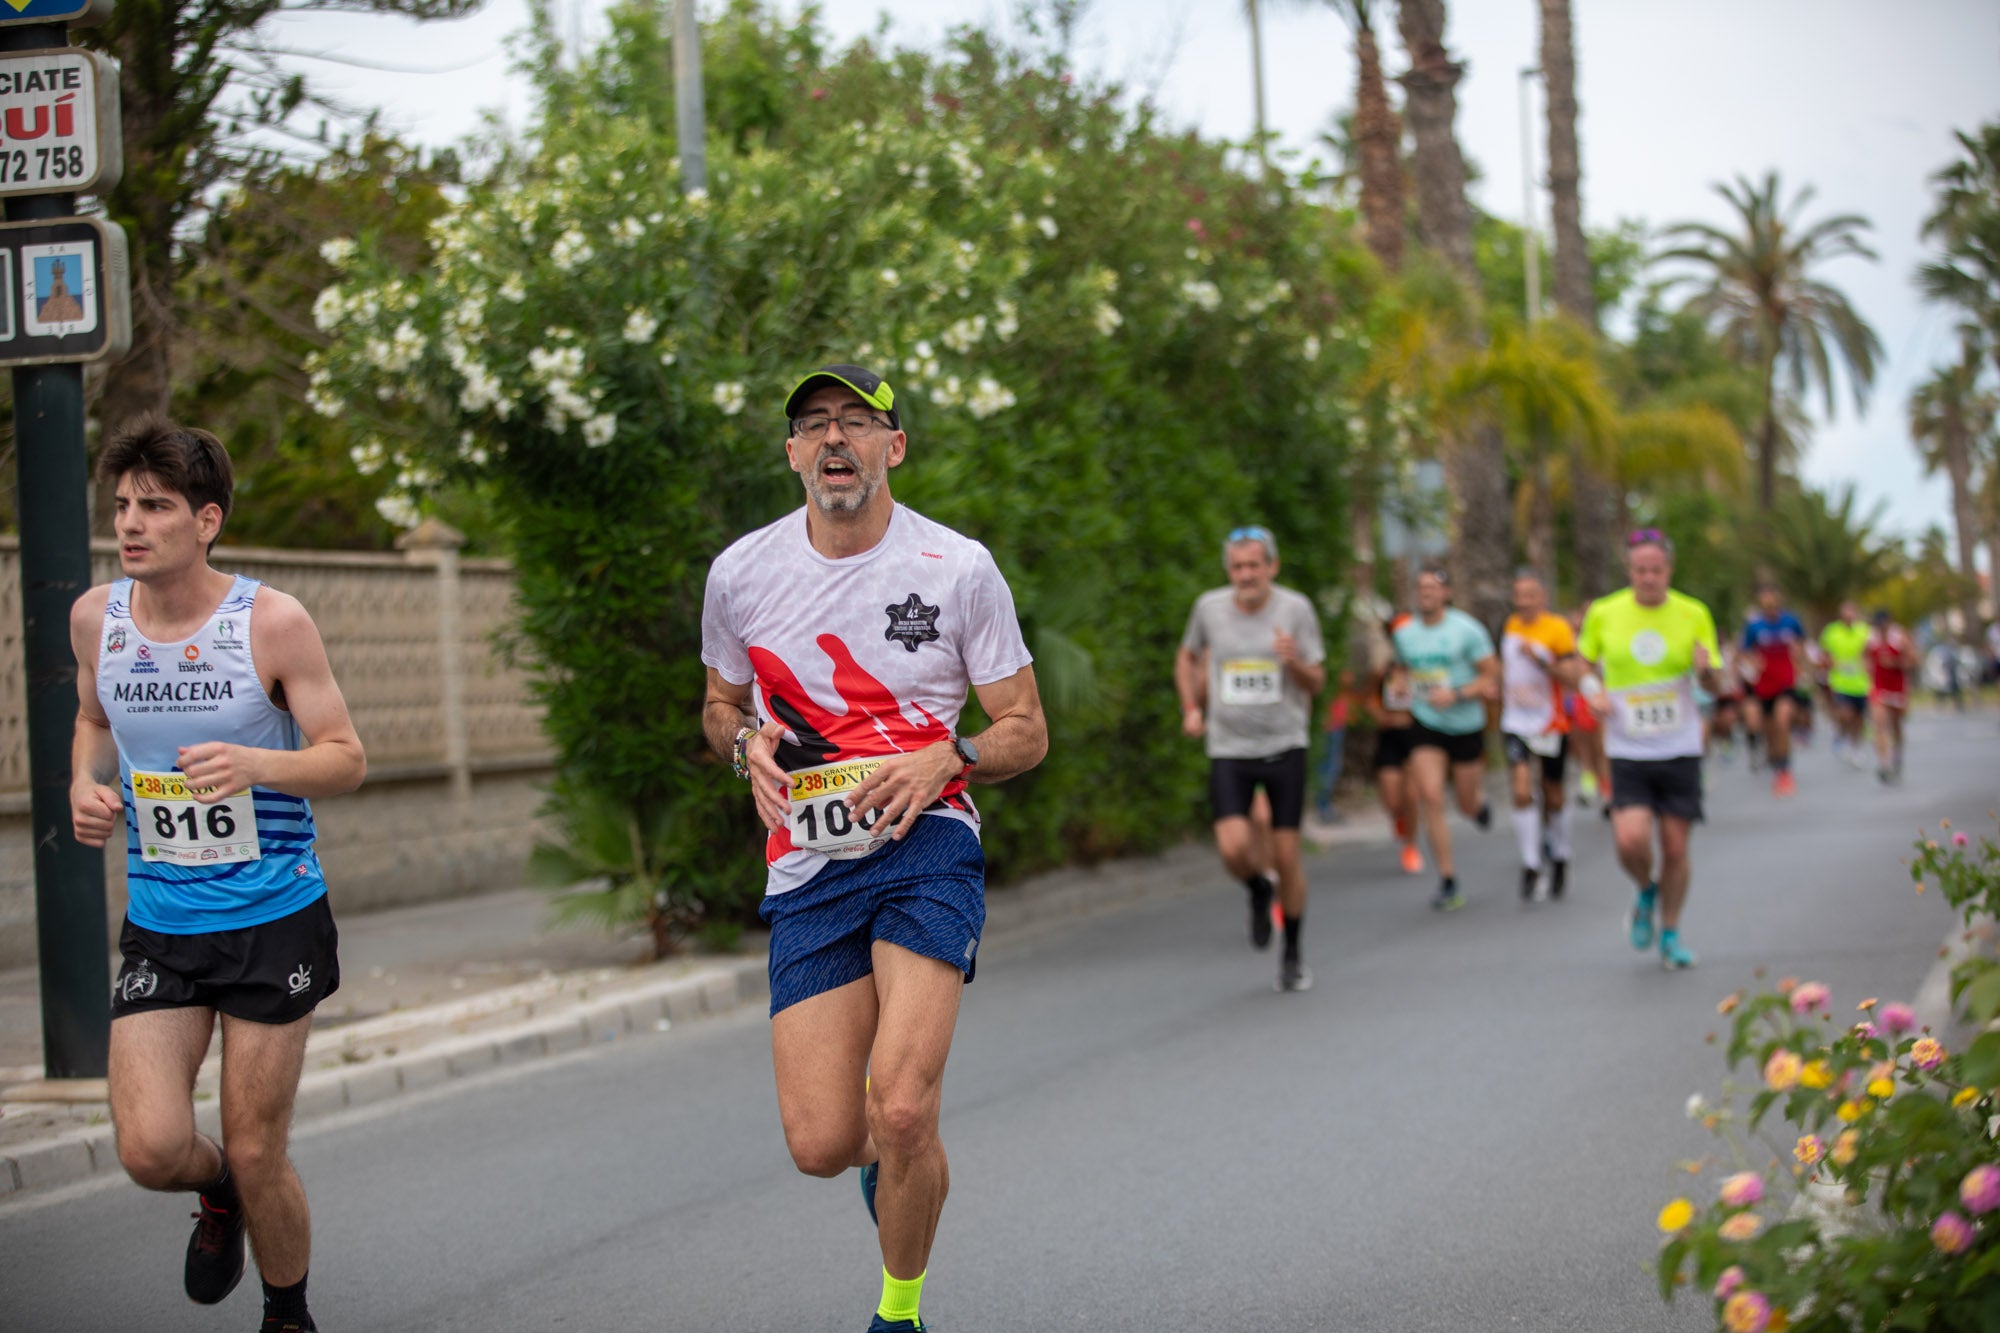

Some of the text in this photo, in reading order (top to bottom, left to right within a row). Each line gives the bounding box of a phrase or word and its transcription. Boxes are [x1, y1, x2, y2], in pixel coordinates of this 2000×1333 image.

[0, 92, 76, 146] UÍ
[36, 146, 83, 180] 758
[114, 680, 234, 701] MARACENA
[127, 704, 219, 713] CLUB DE ATLETISMO
[825, 762, 880, 777] GRAN PREMIO
[145, 778, 161, 793] 38
[804, 773, 823, 791] 38
[153, 804, 236, 840] 816
